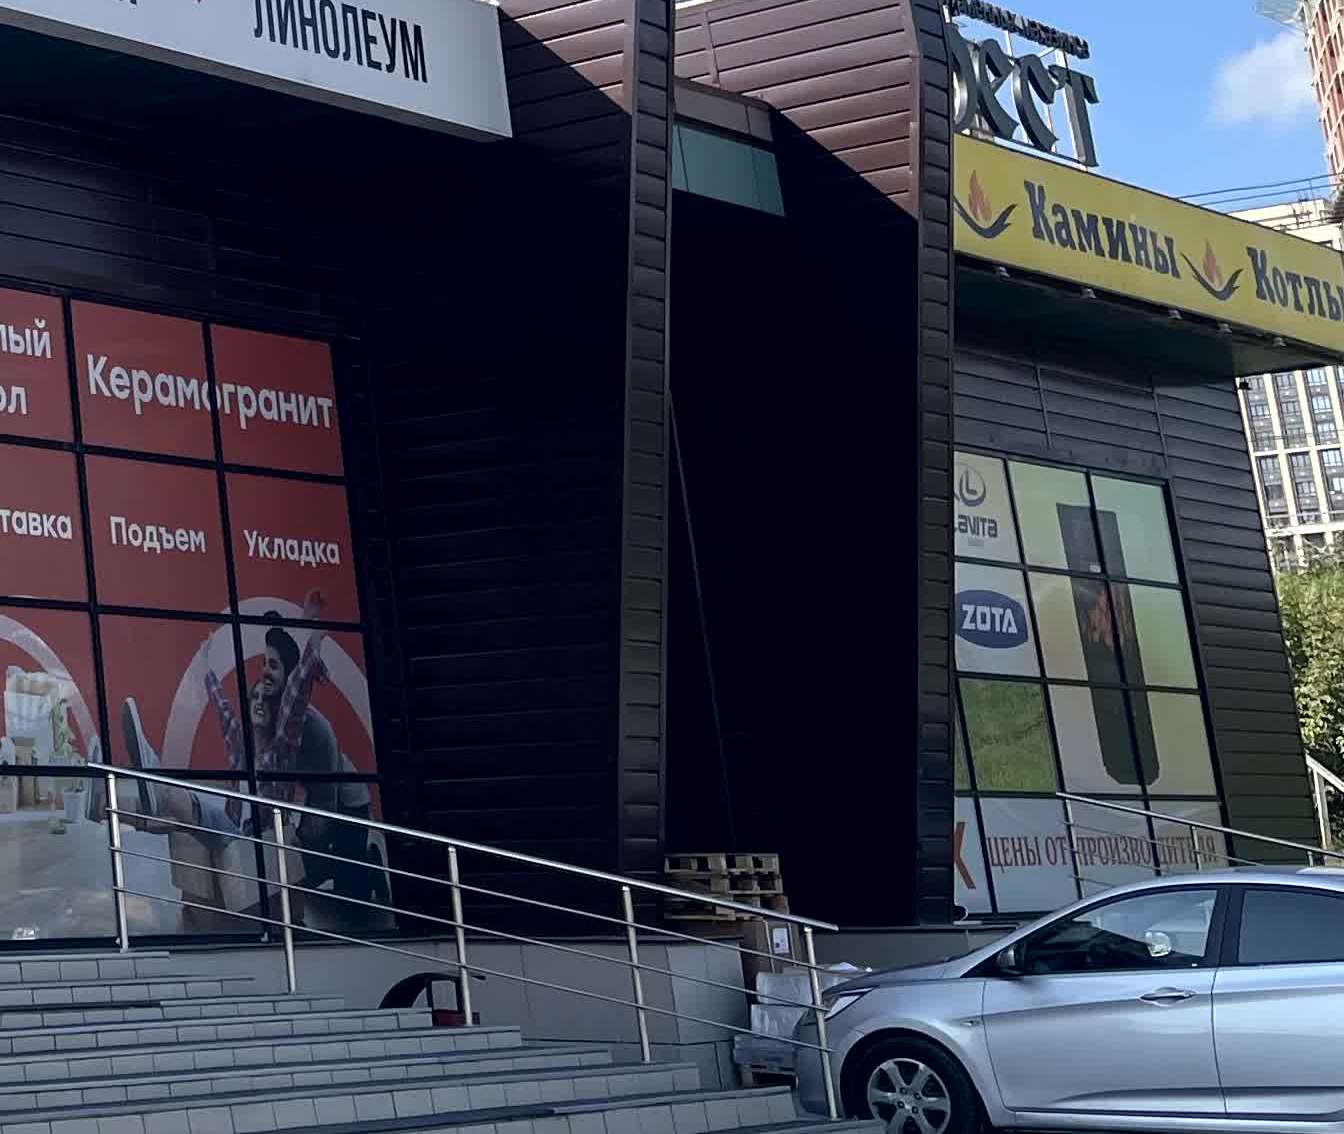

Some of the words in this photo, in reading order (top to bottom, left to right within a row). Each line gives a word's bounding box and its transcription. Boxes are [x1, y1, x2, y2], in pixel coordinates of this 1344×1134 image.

[1023, 179, 1182, 280] Камины
[86, 353, 334, 430] Керамогранит
[109, 515, 207, 554] Подъем
[243, 528, 341, 568] Укладка
[961, 603, 1019, 635] ZOTA
[985, 834, 1041, 874] ЦЕНЫ
[1045, 834, 1069, 866] ОТ
